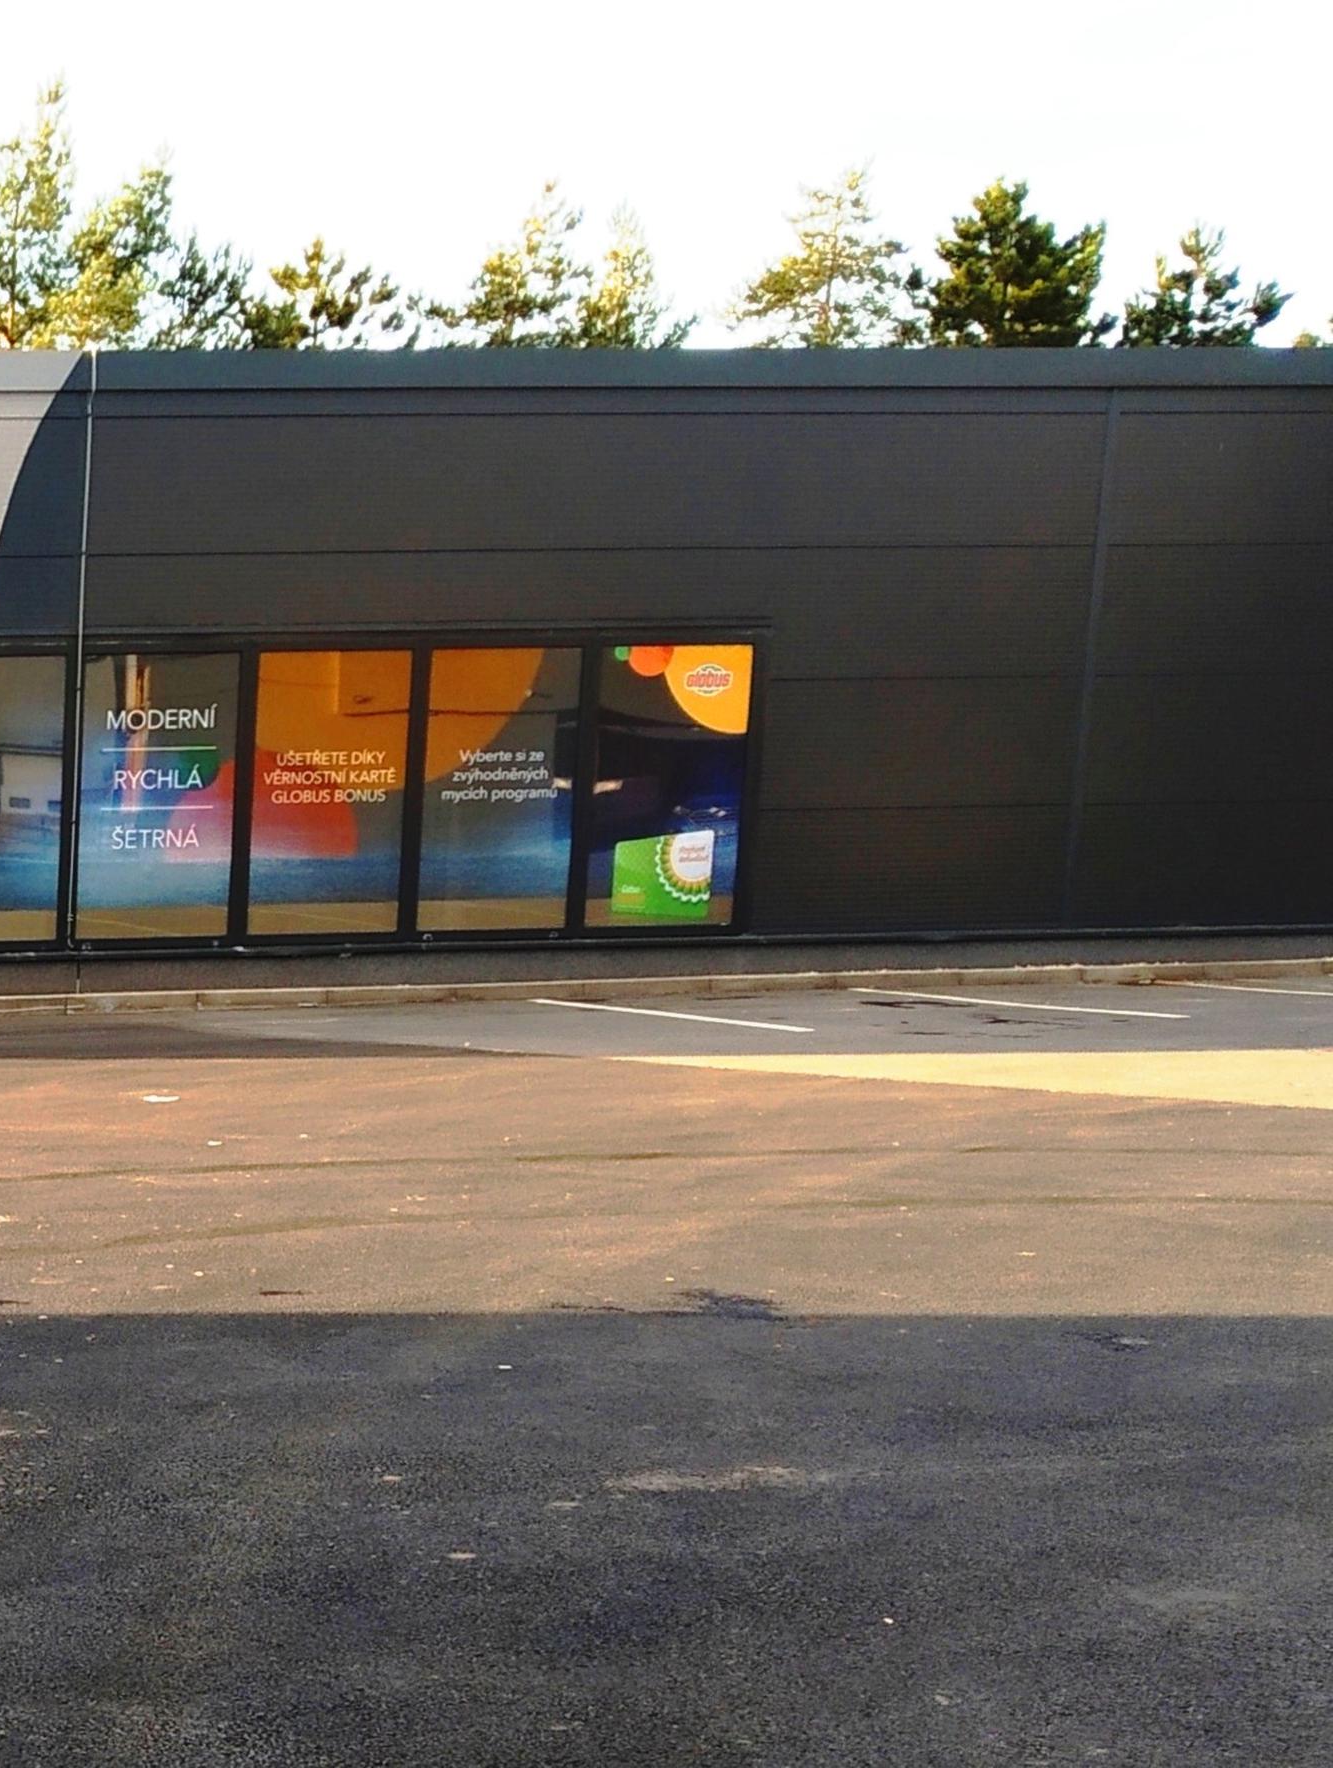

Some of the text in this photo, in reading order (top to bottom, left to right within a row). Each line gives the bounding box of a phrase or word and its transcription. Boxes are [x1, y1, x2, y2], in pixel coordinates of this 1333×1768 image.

[106, 703, 218, 731] MODERNÍ
[276, 748, 386, 766] UŠETŘETE DÍKY
[459, 749, 545, 765] Vyberte si ze
[114, 763, 204, 790] RYCHLÁ
[263, 766, 396, 785] VĚRNOSTNÍ KARTĚ
[452, 767, 549, 784] zvýhodněných
[271, 788, 386, 804] GLOBUS BONUS
[441, 786, 488, 803] mycích
[111, 824, 200, 850] ŠETRNÁ
